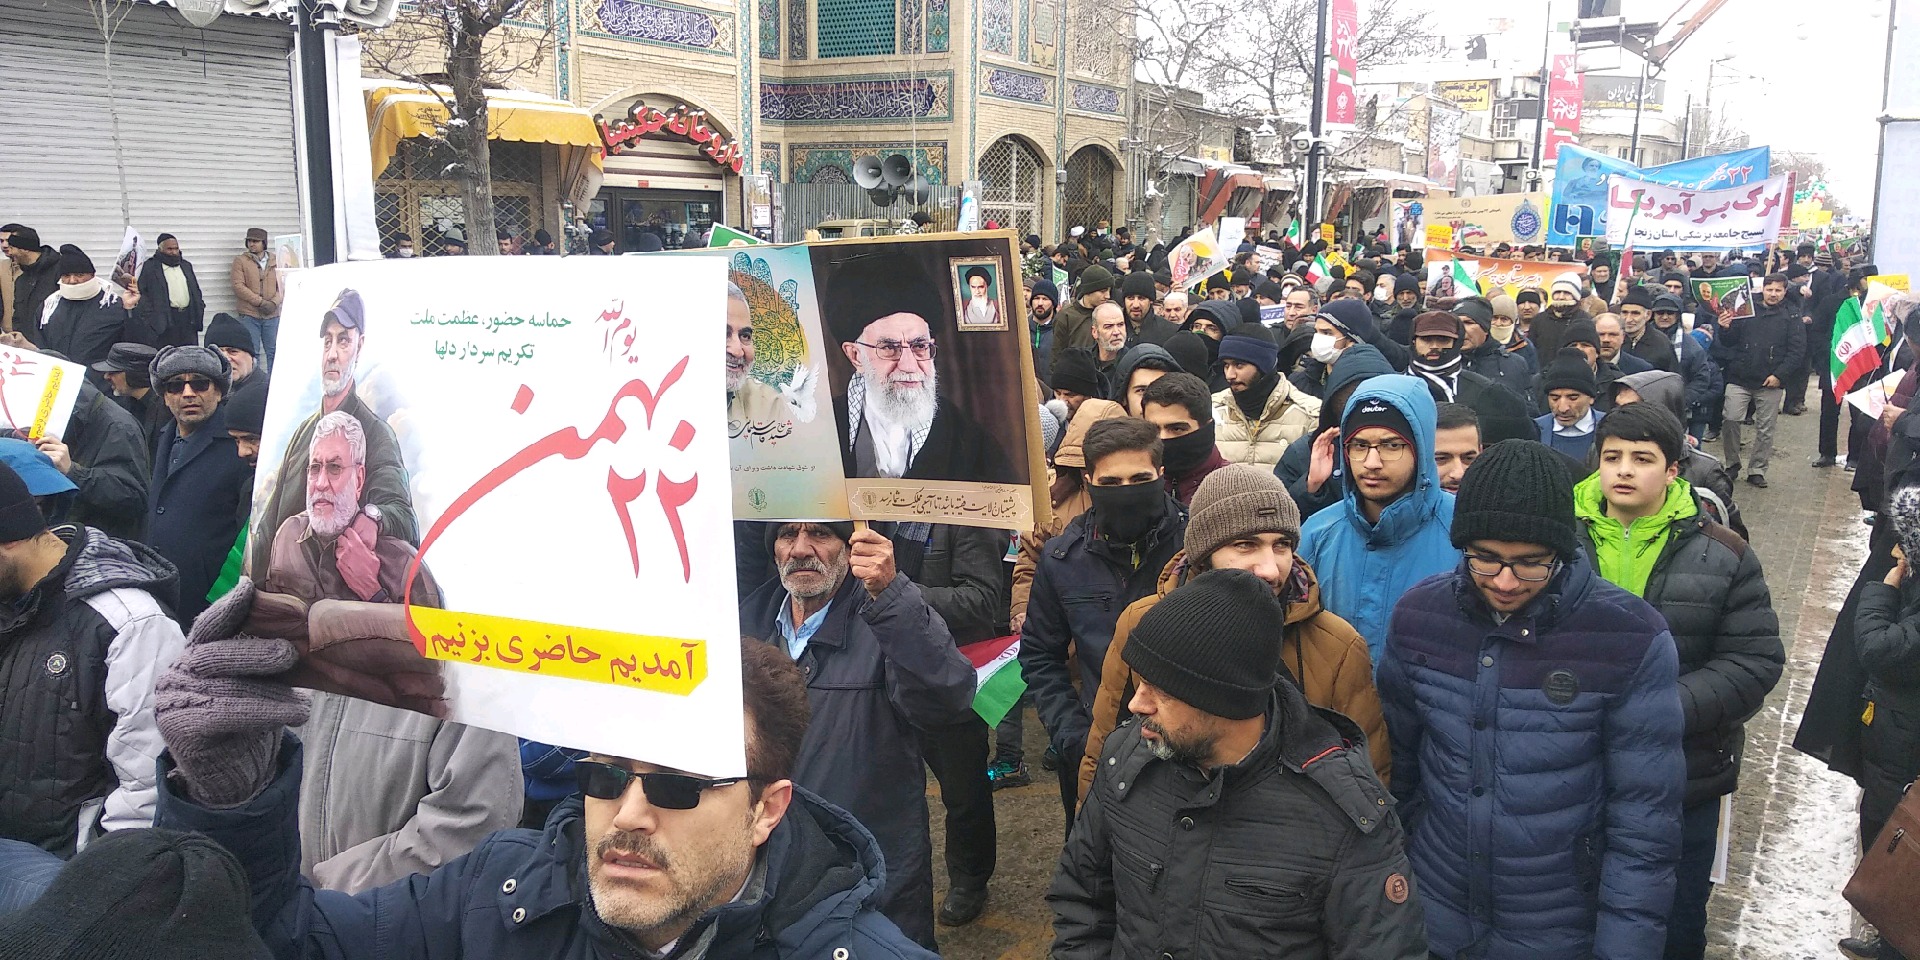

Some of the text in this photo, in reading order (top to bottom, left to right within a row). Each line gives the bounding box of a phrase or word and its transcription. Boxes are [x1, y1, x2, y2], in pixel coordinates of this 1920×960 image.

[600, 105, 667, 160] حکیمیا
[1727, 165, 1754, 185] ۲۲
[1610, 184, 1695, 220] آمریکا
[1692, 200, 1731, 224] بر
[1634, 228, 1652, 240] زنجا
[1653, 229, 1678, 240] استان
[1713, 228, 1740, 240] جامعه
[1740, 228, 1765, 240] بسیج
[410, 308, 435, 325] ملت
[437, 309, 479, 326] عظمت
[528, 311, 572, 328] حماسه
[434, 340, 535, 366] تکریم سردار دلها
[1361, 405, 1388, 413] deuter
[404, 355, 697, 658] بهمن
[606, 464, 699, 584] ۲۲
[431, 622, 700, 683] آمدیم حاضری بزنیم
